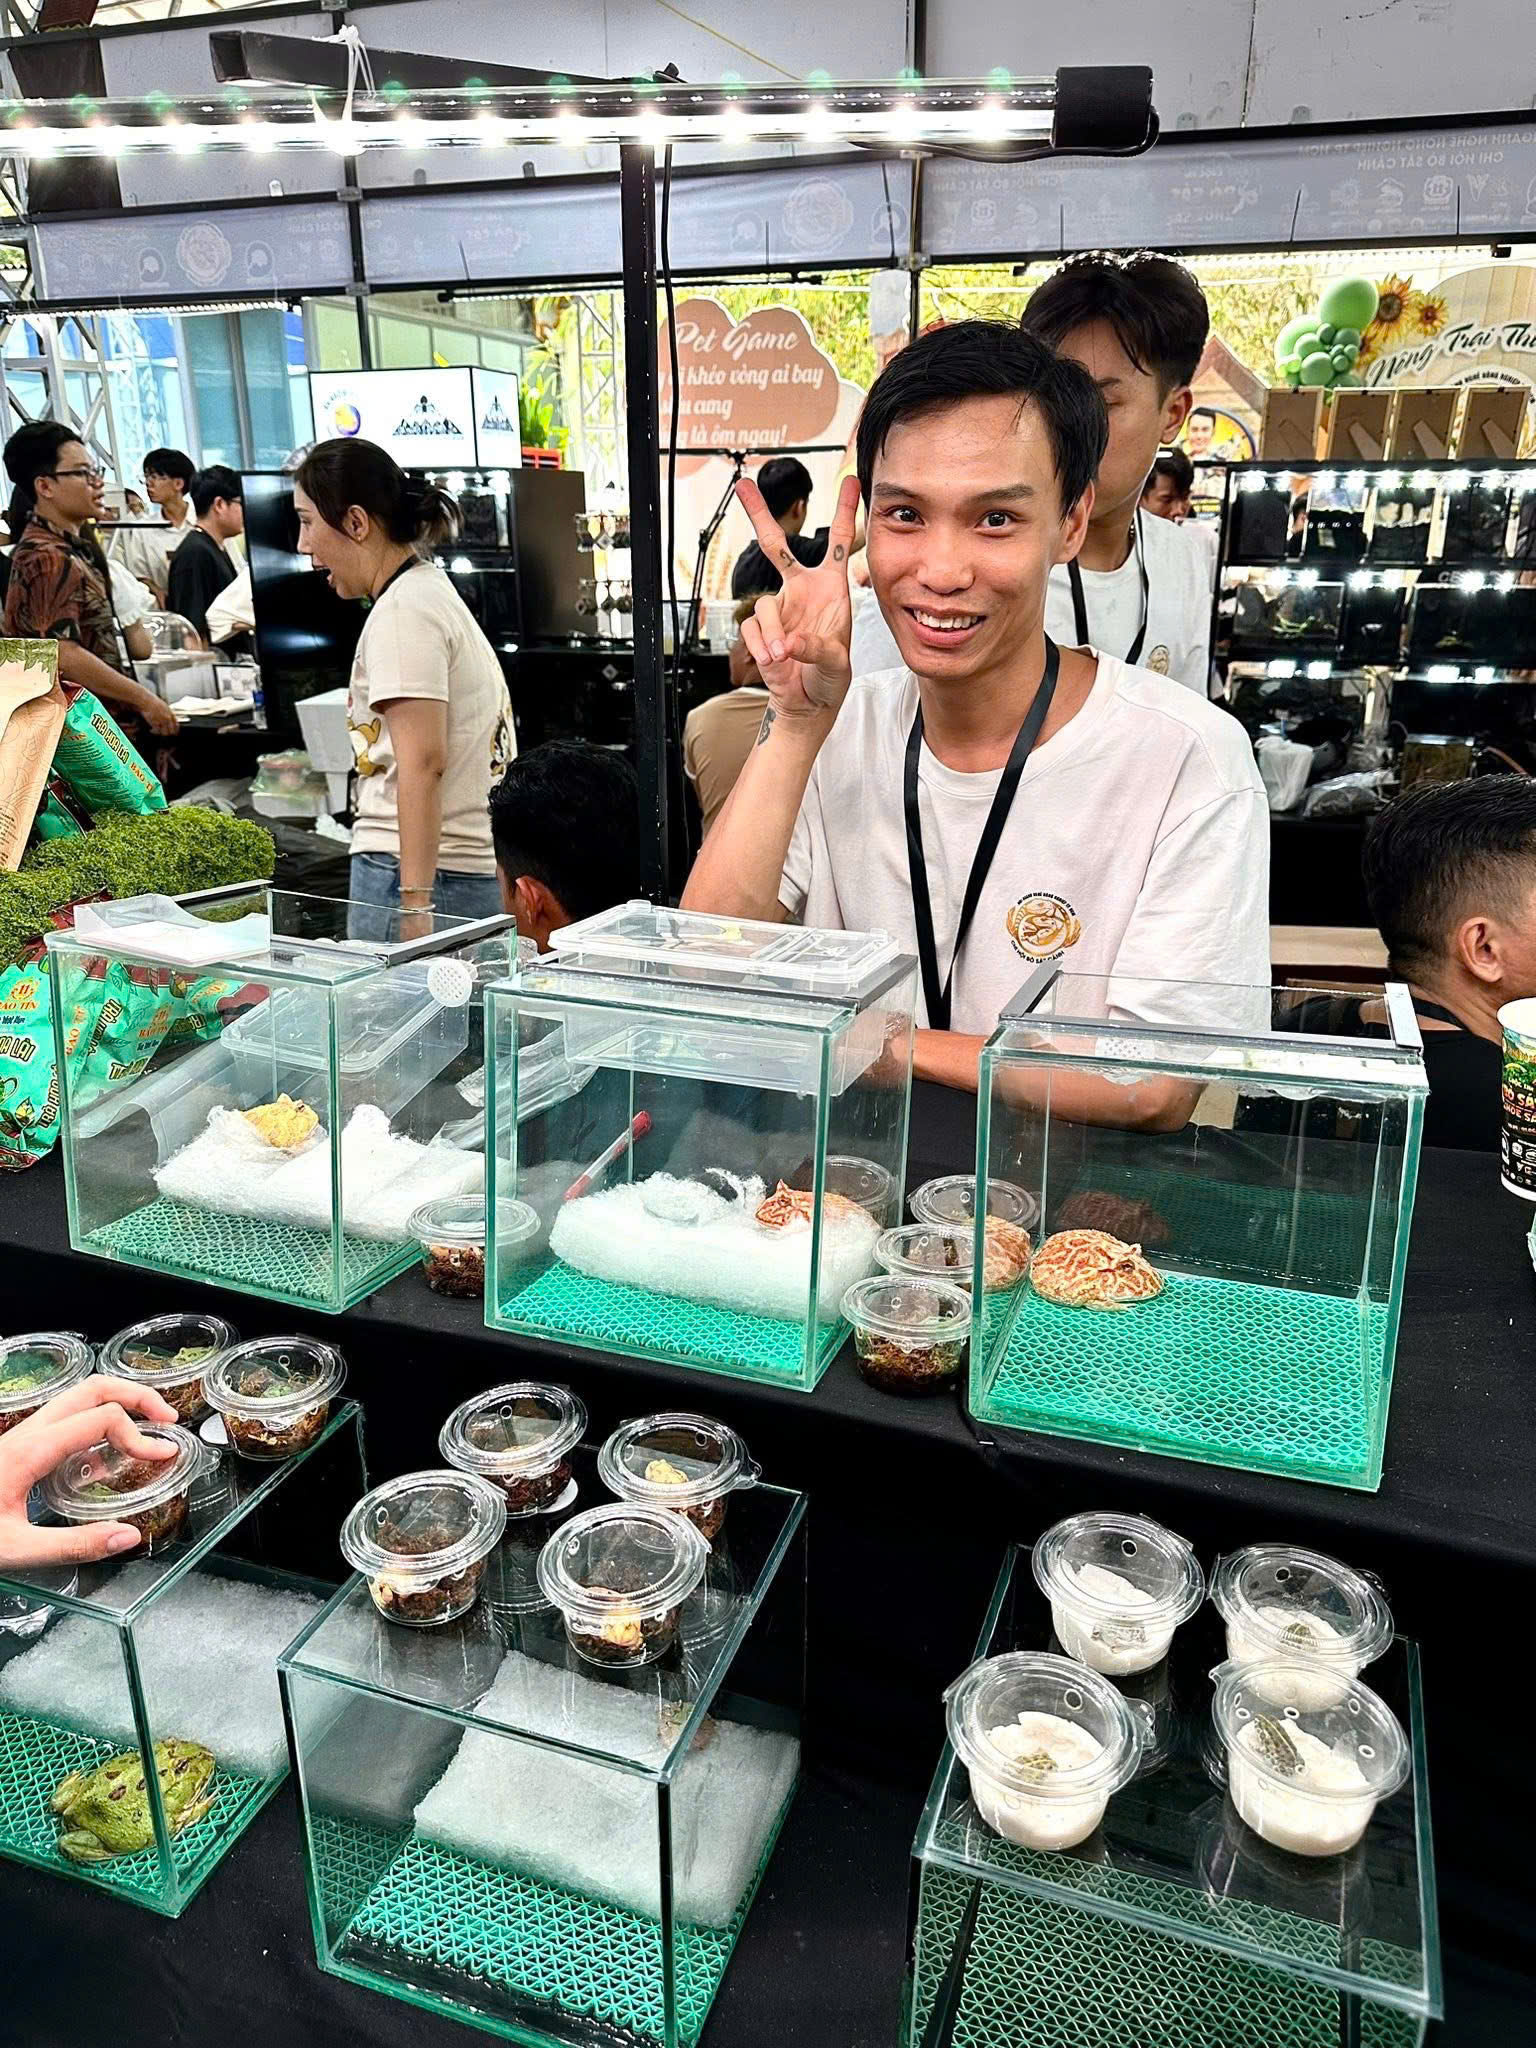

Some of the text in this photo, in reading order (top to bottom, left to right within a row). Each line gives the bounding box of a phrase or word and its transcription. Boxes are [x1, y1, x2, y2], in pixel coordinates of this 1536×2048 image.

[675, 321, 799, 361] Pet Game
[686, 363, 726, 386] khéo
[729, 363, 769, 391] vòng
[771, 363, 789, 386] ai
[792, 363, 824, 391] bay
[1516, 1091, 1536, 1110] SÁ
